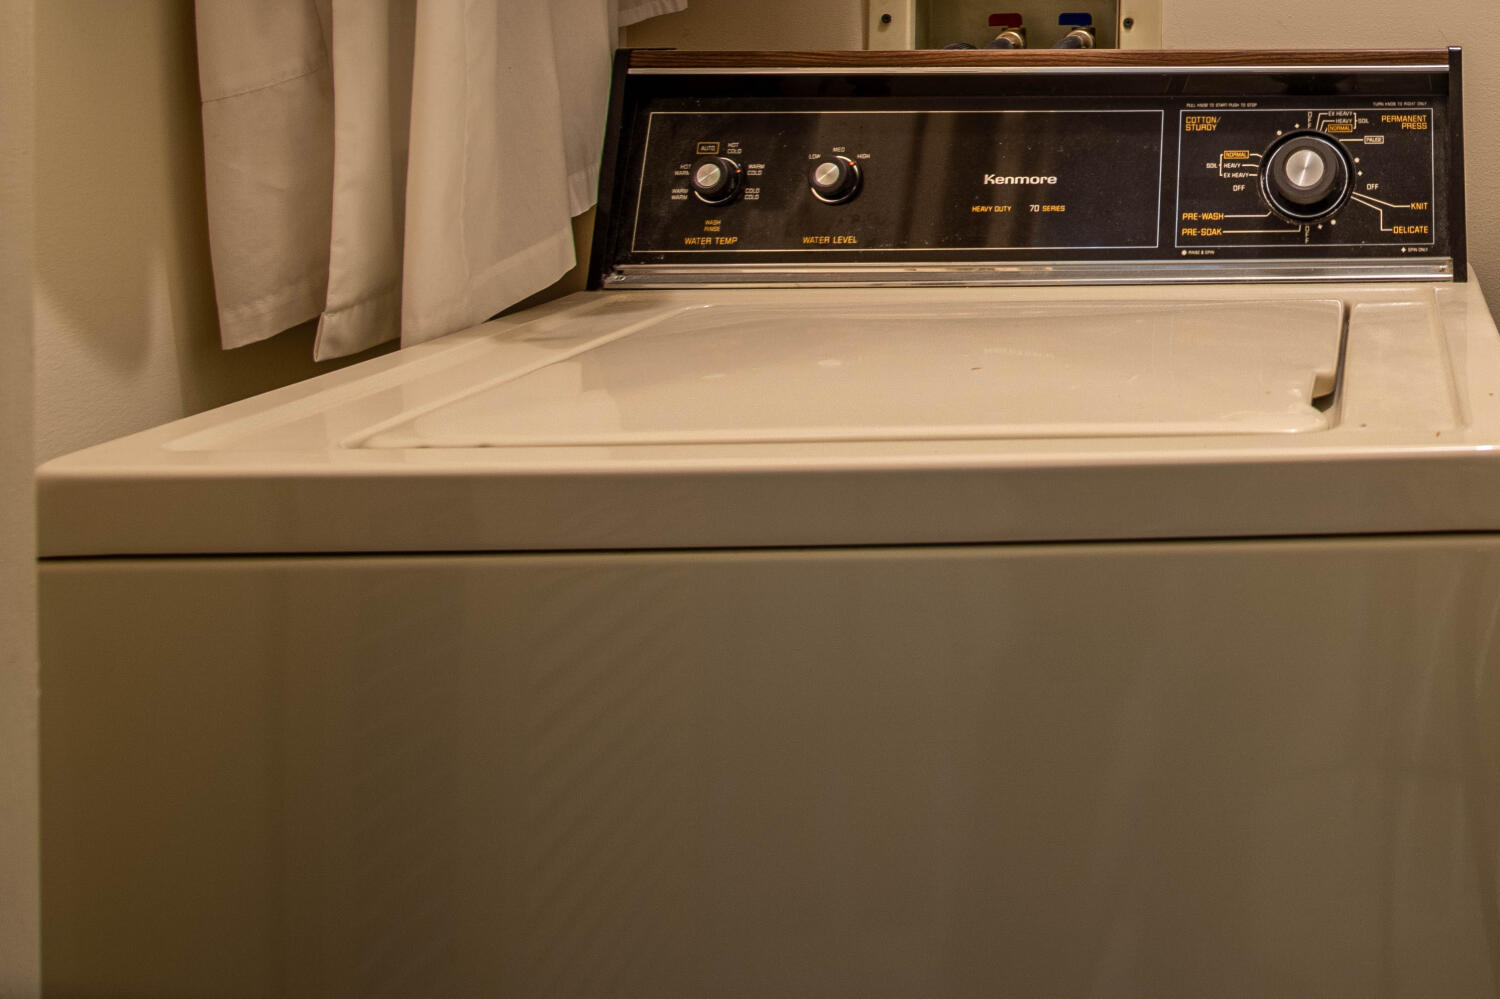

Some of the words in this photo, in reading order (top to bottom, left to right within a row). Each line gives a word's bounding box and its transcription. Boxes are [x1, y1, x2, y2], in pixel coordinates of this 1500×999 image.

[1381, 115, 1427, 123] PERMANENT
[983, 174, 1058, 185] Kenmore
[1029, 204, 1040, 212] 70
[1411, 202, 1428, 210] KNIT
[1181, 228, 1222, 236] PRE-SOAK
[1393, 226, 1429, 234] DELICATE
[684, 237, 712, 245] WATER
[715, 237, 738, 245] TEMP
[802, 236, 830, 244] WATER
[832, 236, 858, 244] LEVEL
